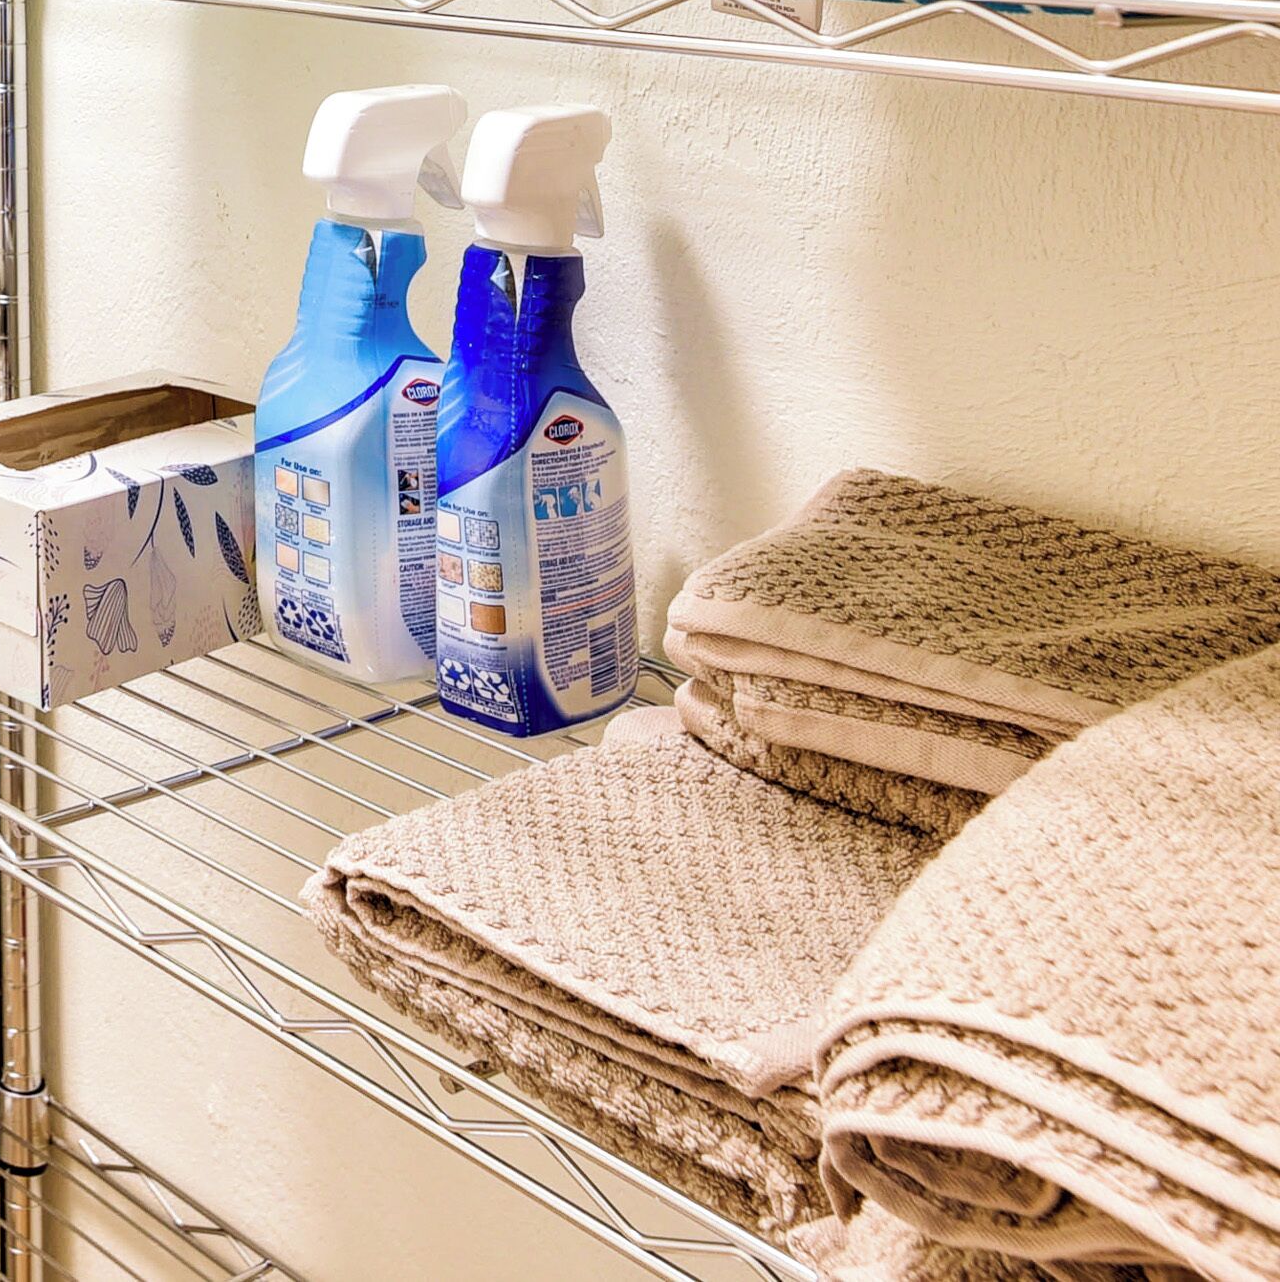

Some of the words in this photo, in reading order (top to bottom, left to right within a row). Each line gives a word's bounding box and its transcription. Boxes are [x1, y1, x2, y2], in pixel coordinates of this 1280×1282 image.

[548, 422, 580, 439] CLOROX
[531, 455, 568, 466] DIRECTIONS
[570, 453, 581, 462] FOR
[293, 462, 307, 473] Use
[463, 507, 475, 515] Use
